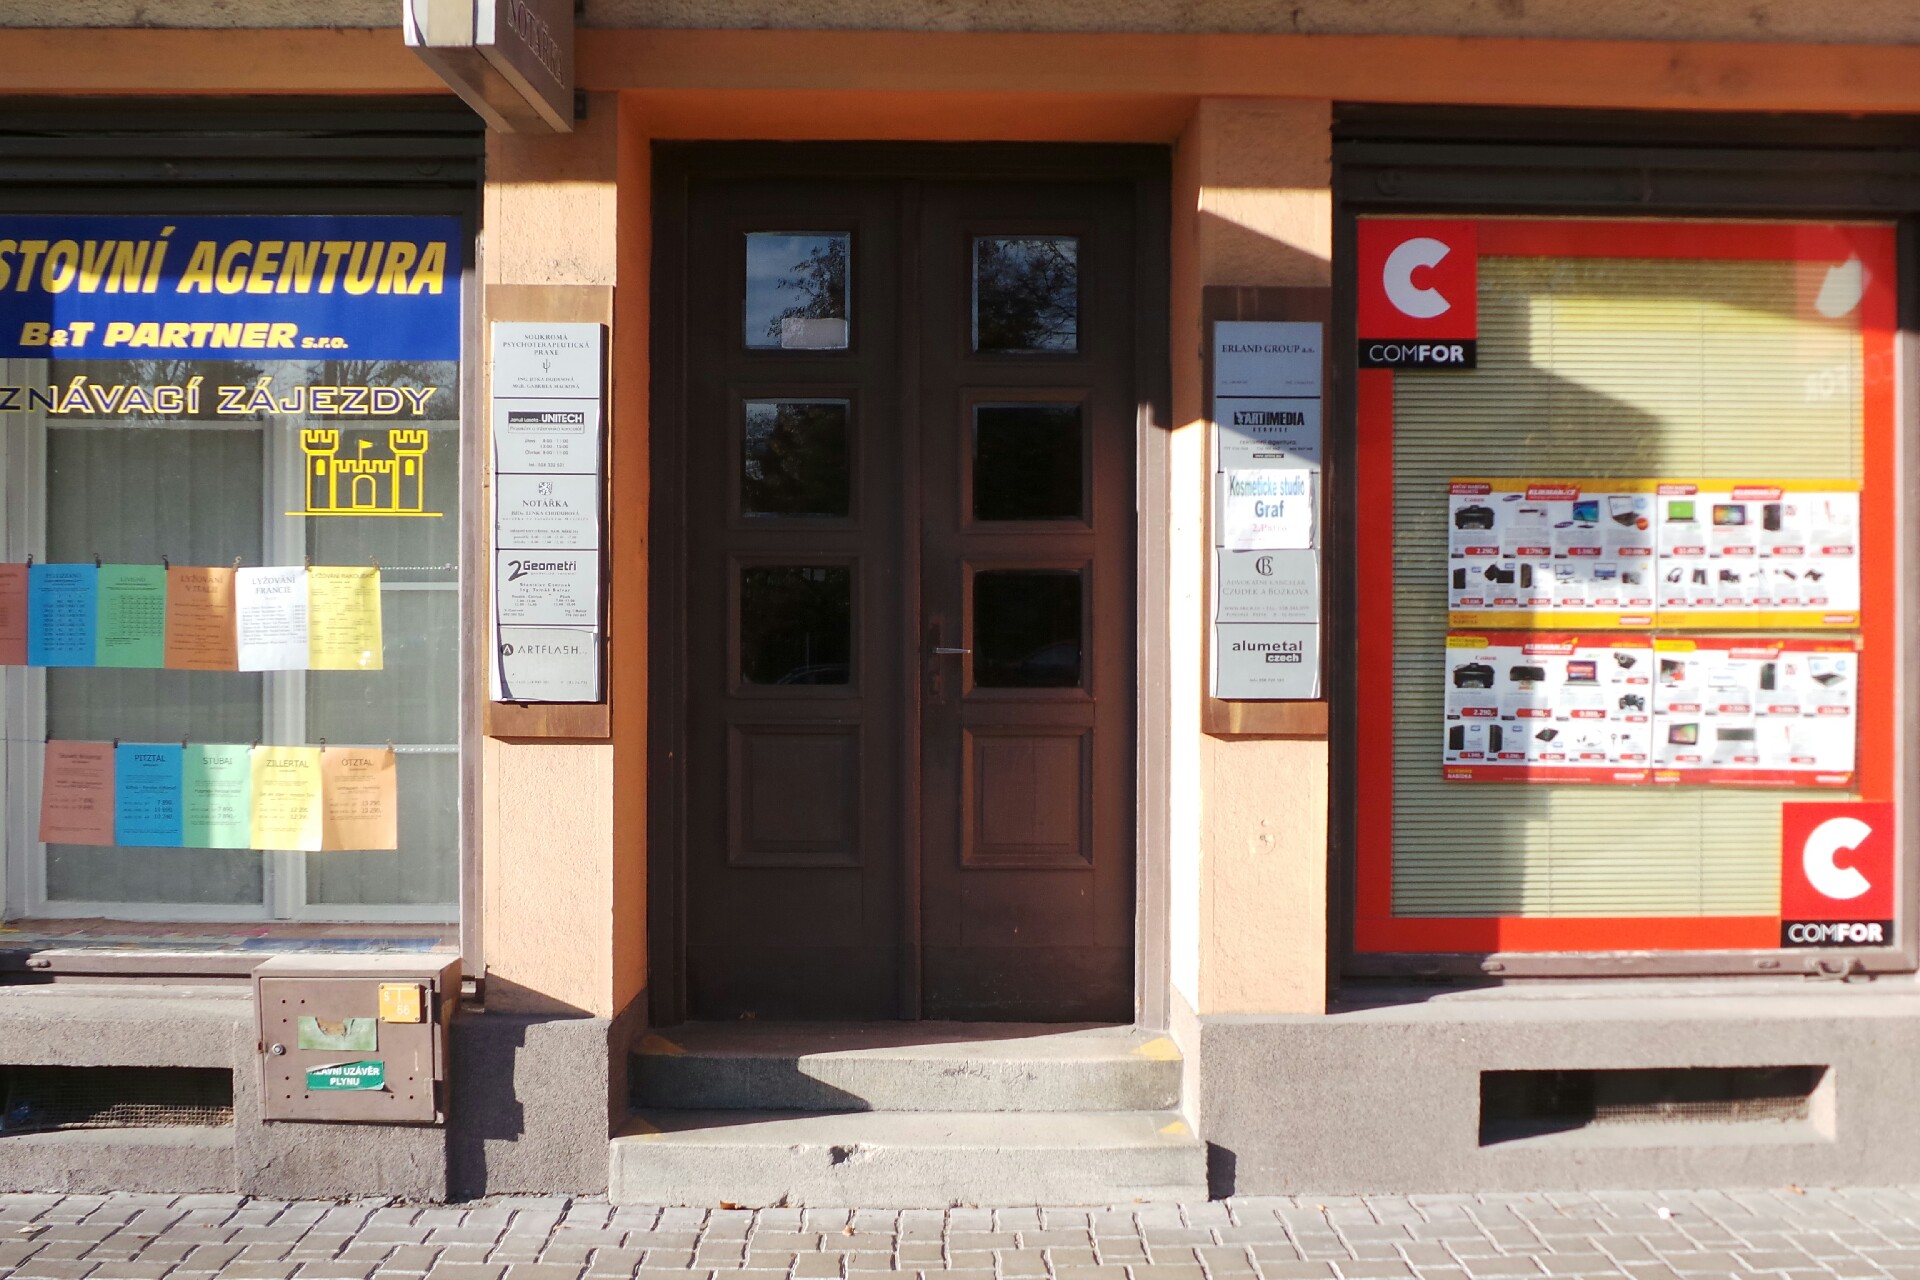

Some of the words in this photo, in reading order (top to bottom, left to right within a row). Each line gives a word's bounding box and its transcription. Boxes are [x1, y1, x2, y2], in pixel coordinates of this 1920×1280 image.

[176, 240, 447, 295] AGENTURA
[19, 322, 95, 347] B&T
[102, 322, 299, 349] PARTNER
[301, 336, 349, 349] s.r.o.
[1222, 344, 1262, 353] ERLAND
[1264, 344, 1300, 353] GROUP
[1369, 345, 1465, 362] COMFOR
[216, 376, 438, 415] ZÁJEZDY
[541, 413, 582, 423] UNITECH
[1280, 475, 1305, 496] studio
[522, 497, 569, 507] NOTÁŘKA
[1254, 500, 1285, 518] Graf
[255, 586, 292, 595] FRANCIE
[517, 645, 579, 654] ARTFLASH
[1232, 640, 1302, 651] alumetal
[1267, 653, 1300, 662] czech
[134, 754, 166, 762] PITZTAL
[203, 757, 233, 765] STUBAI
[266, 759, 309, 768] ZILLERTAL
[1788, 923, 1884, 942] COMFOR
[344, 1065, 380, 1076] UZÁVĚR
[329, 1077, 360, 1086] PLYNU
